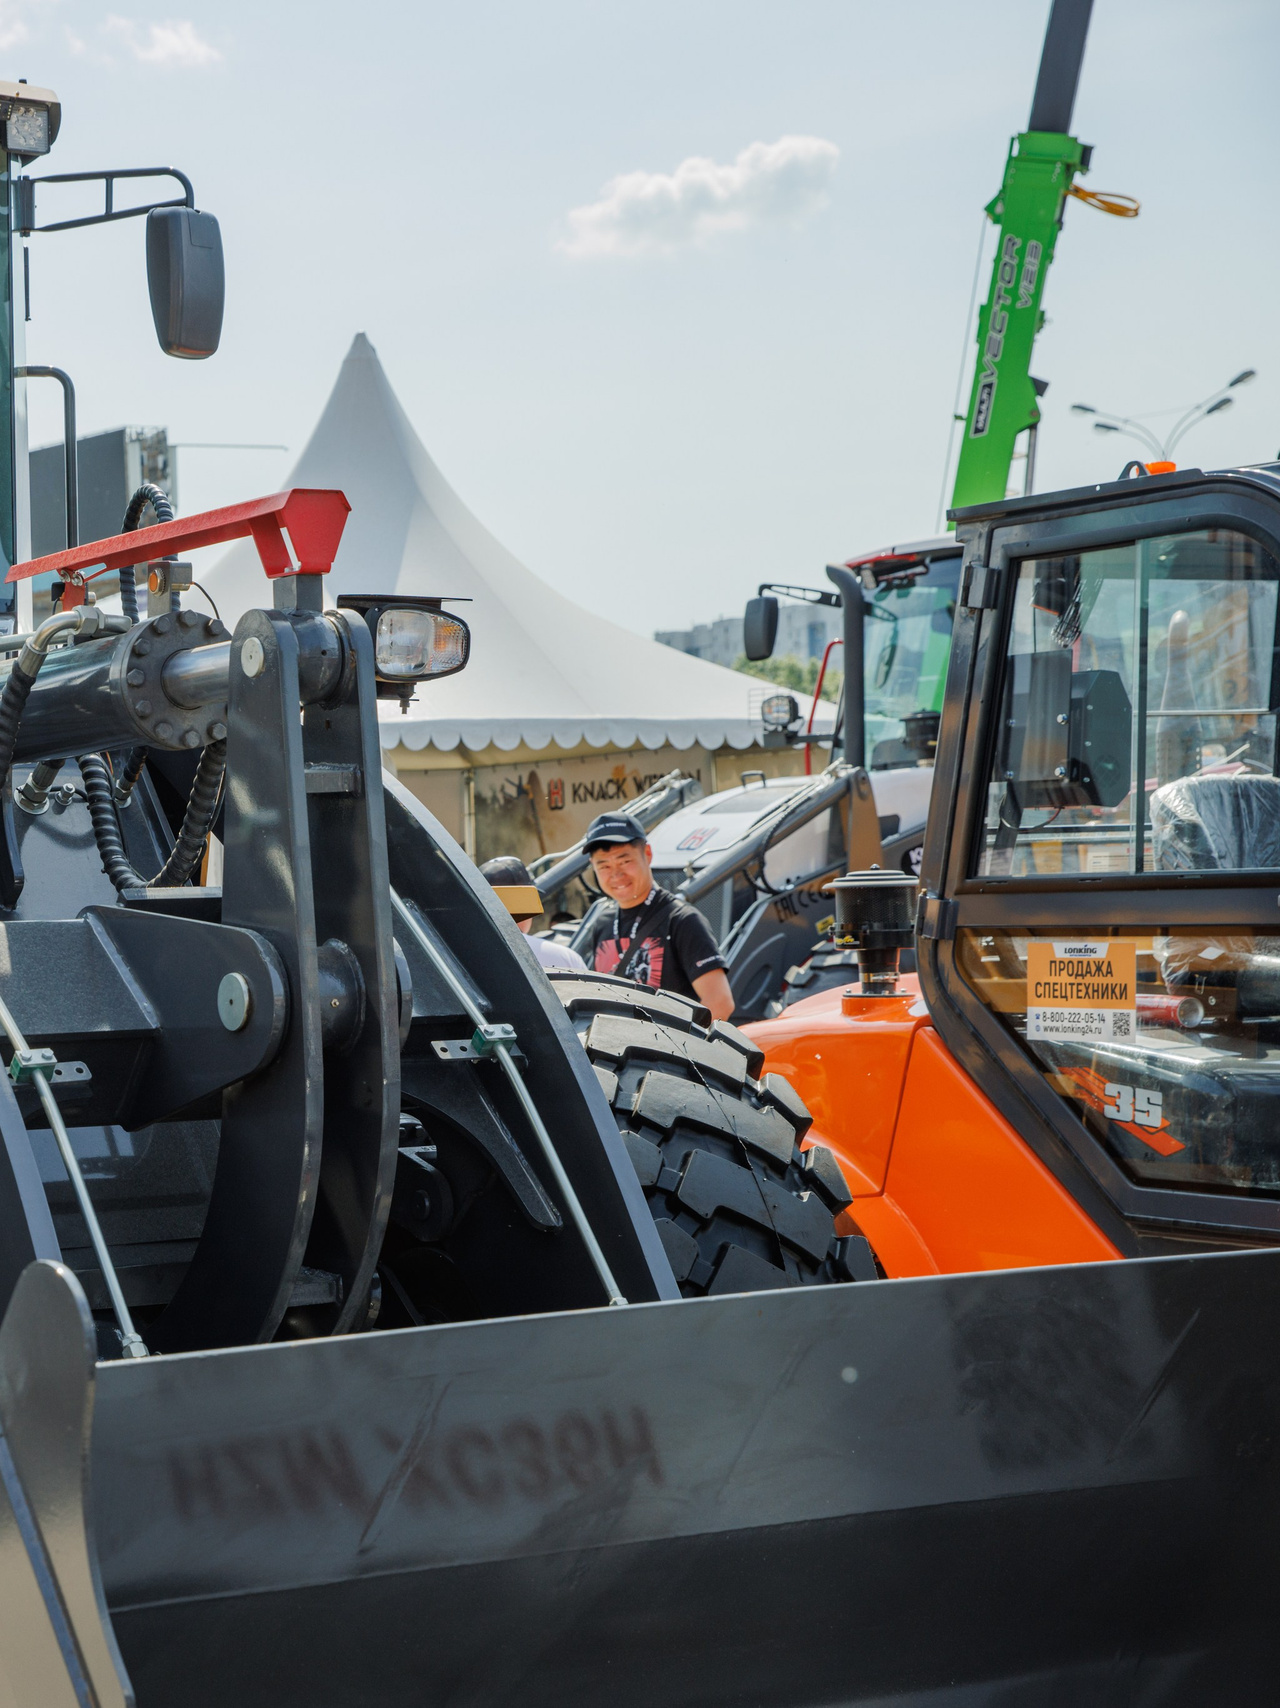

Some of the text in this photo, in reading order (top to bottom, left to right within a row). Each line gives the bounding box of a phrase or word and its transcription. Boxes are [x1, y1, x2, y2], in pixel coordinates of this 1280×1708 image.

[979, 234, 1022, 381] VECTOR
[572, 777, 627, 804] KNACK
[1049, 960, 1113, 979] ПРОДАЖА
[1035, 982, 1128, 1001] СПЕЦТЕХНИКИ
[1042, 1012, 1106, 1024] 8-800-222-05-14
[1043, 1025, 1102, 1036] www.lonking24.ru
[1104, 1082, 1163, 1128] 35
